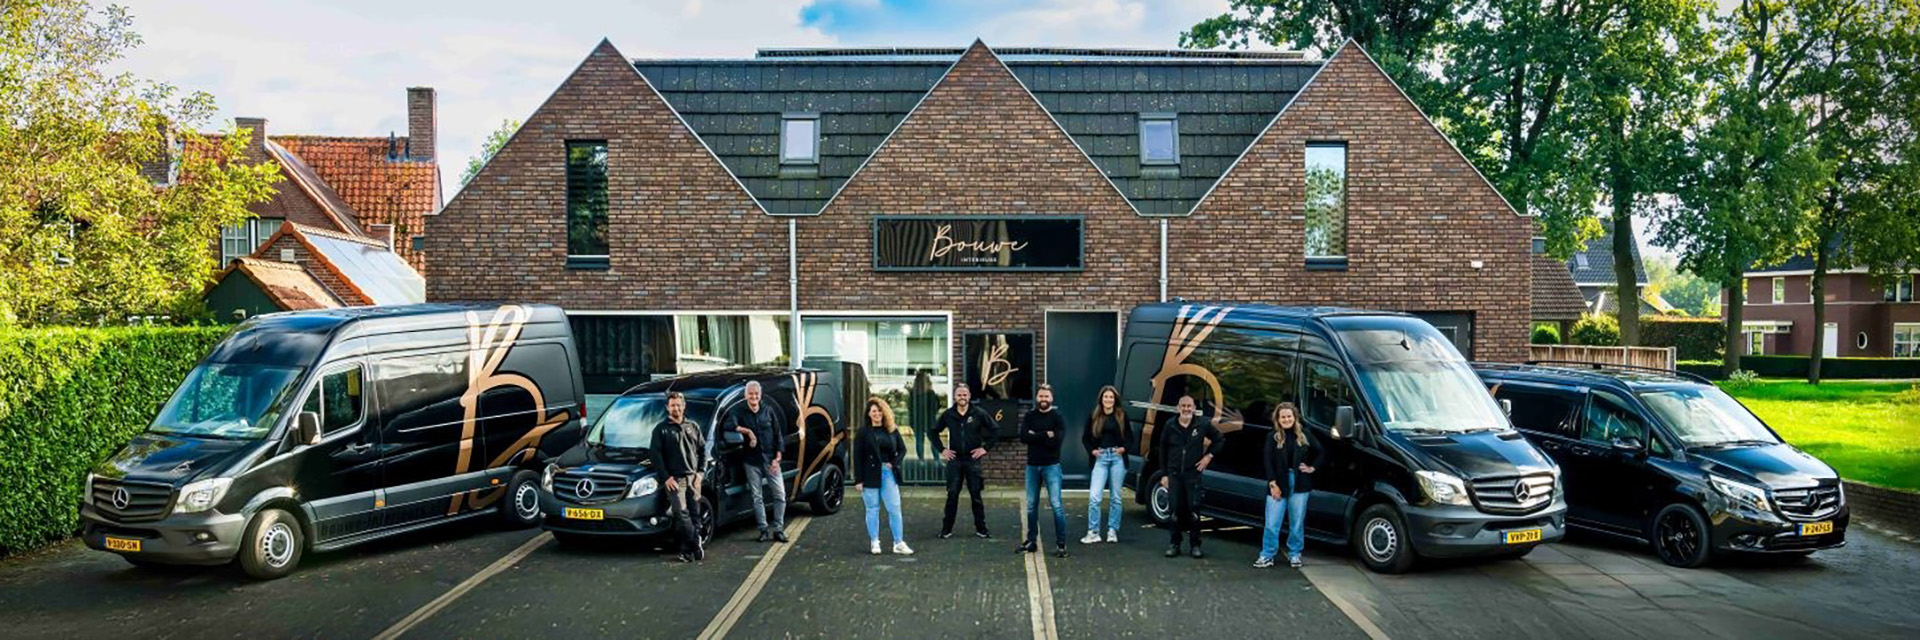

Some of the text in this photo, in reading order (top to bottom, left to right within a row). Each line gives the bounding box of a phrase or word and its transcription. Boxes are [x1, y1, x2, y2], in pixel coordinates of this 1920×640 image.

[930, 224, 1029, 261] Bouwe
[981, 344, 1019, 391] B
[995, 408, 1003, 422] 6
